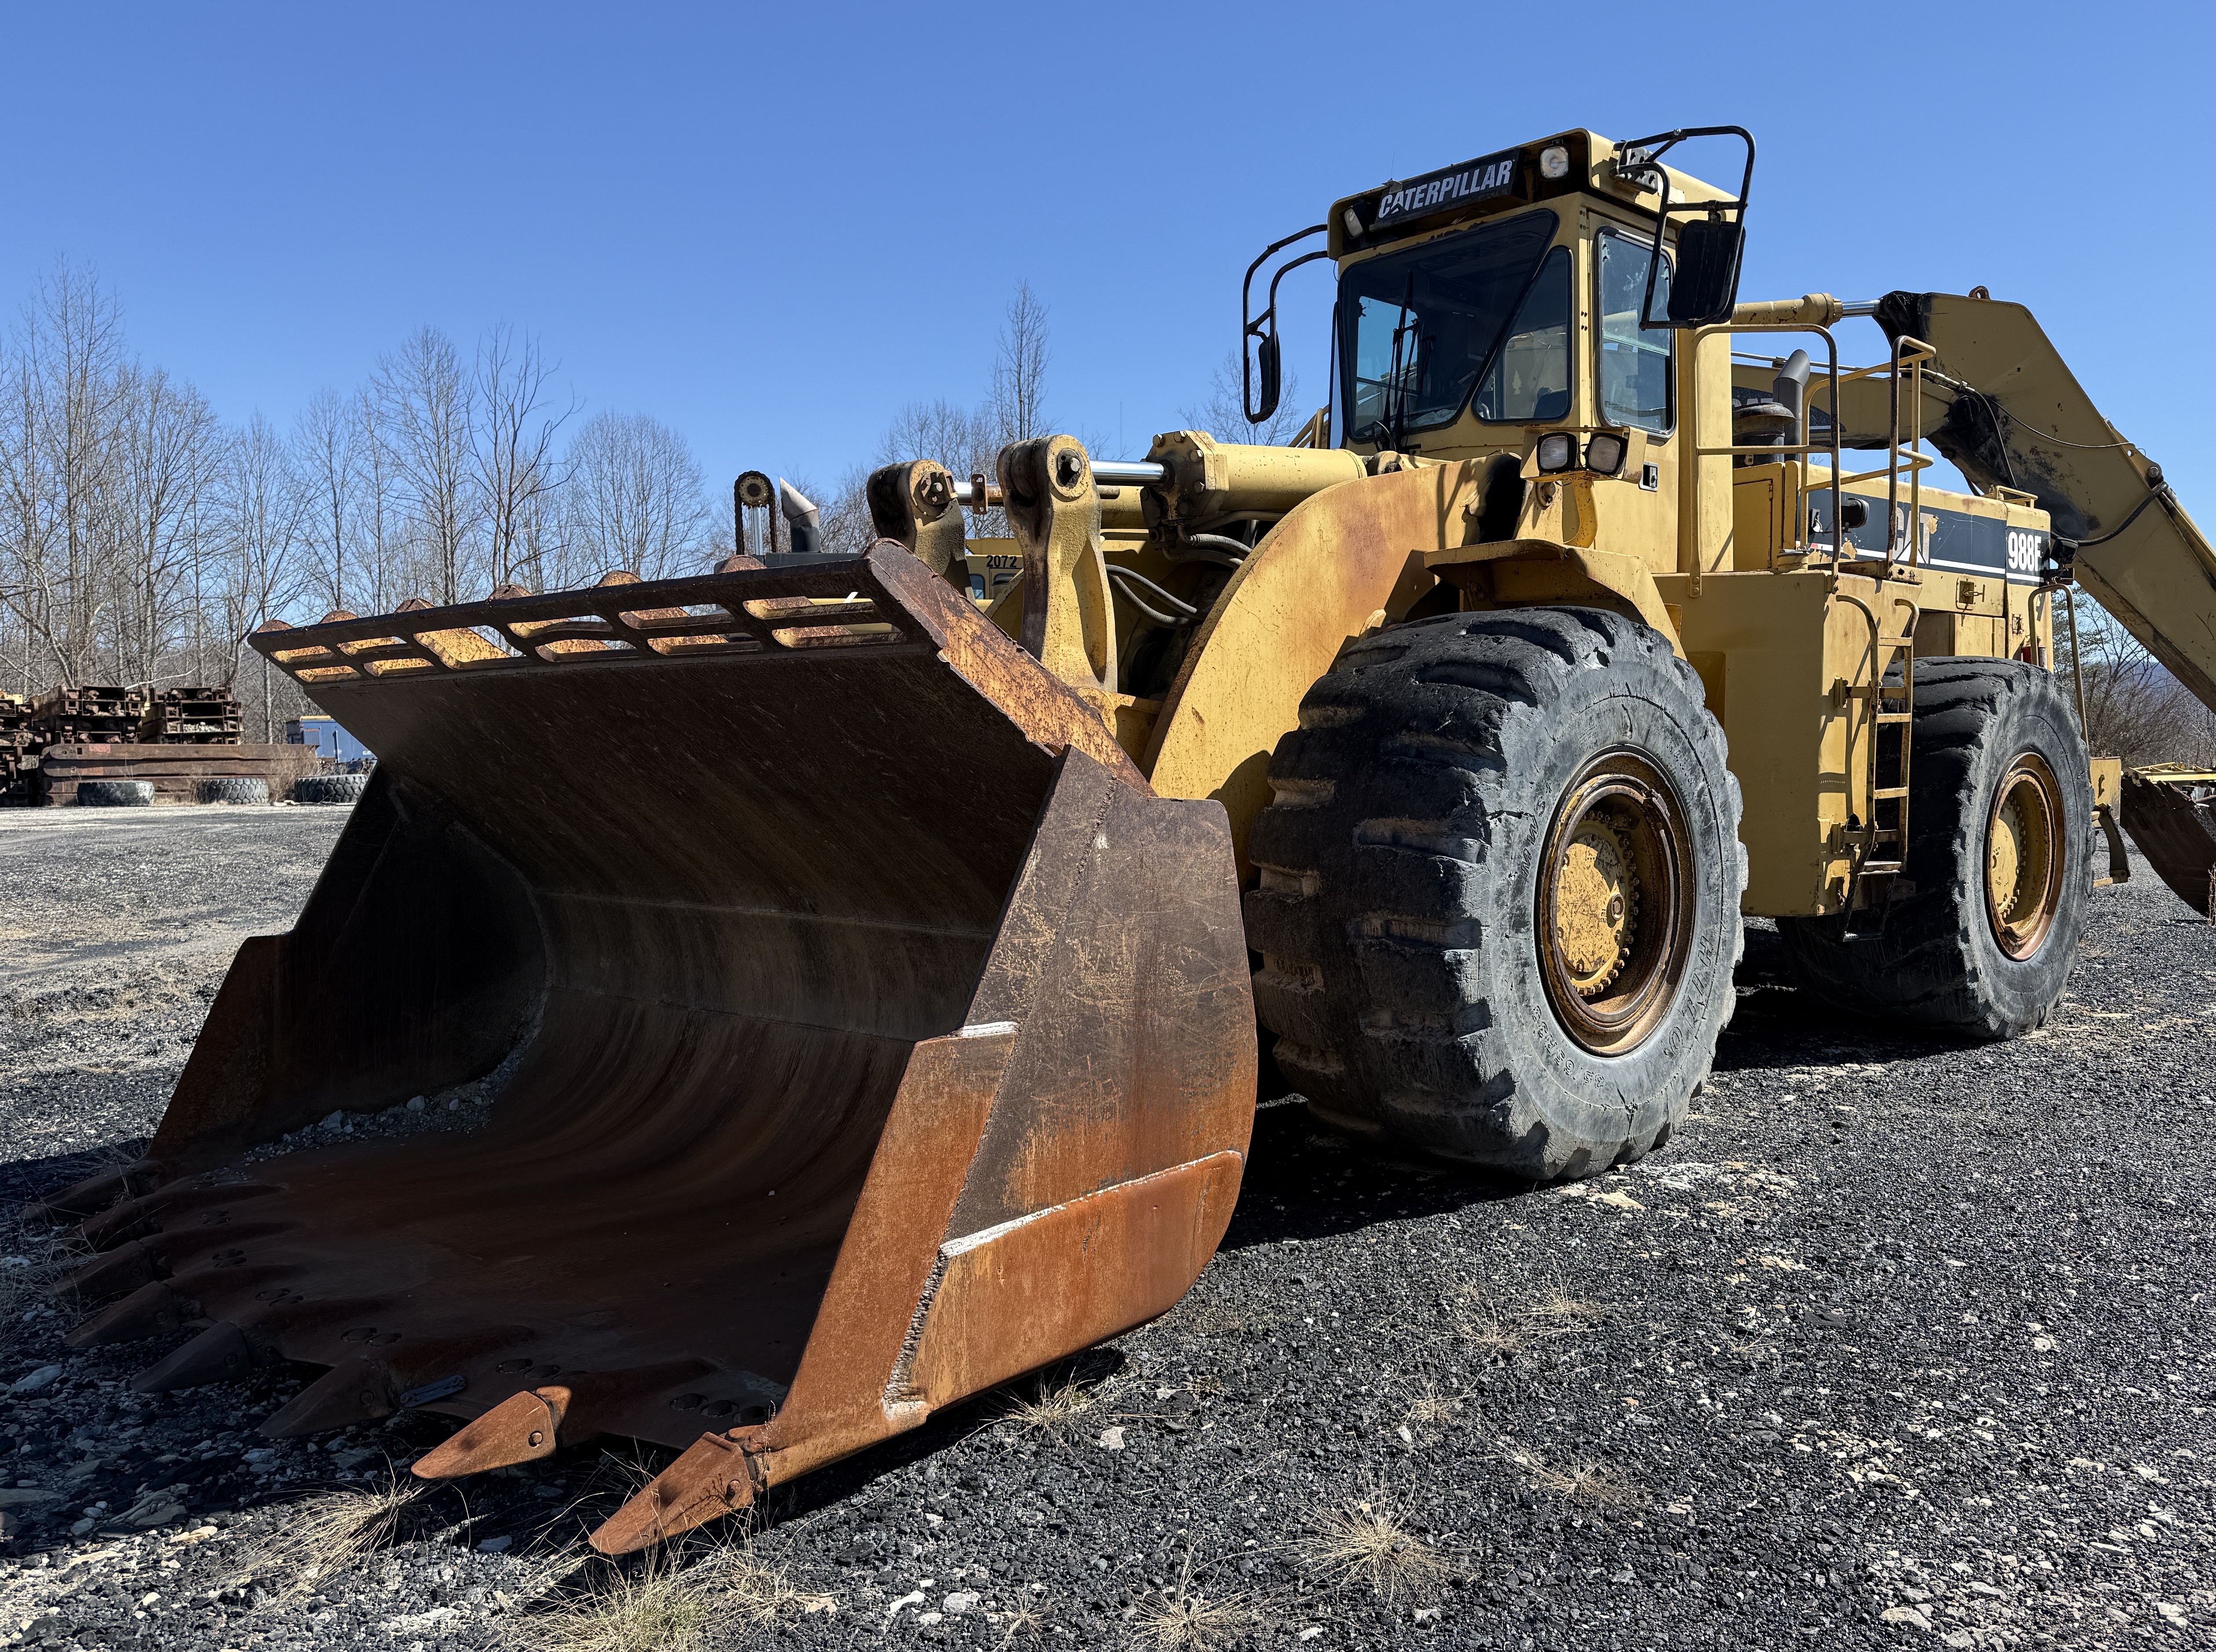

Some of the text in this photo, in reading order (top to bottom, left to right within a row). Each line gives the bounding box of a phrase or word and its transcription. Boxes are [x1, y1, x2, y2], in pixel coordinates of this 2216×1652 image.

[1378, 160, 1513, 218] CATERPILLAR
[986, 555, 1017, 567] 2072
[2008, 531, 2042, 571] 988F
[1669, 935, 1714, 1057] HILO
[1531, 1005, 1605, 1089] 35/65R33
